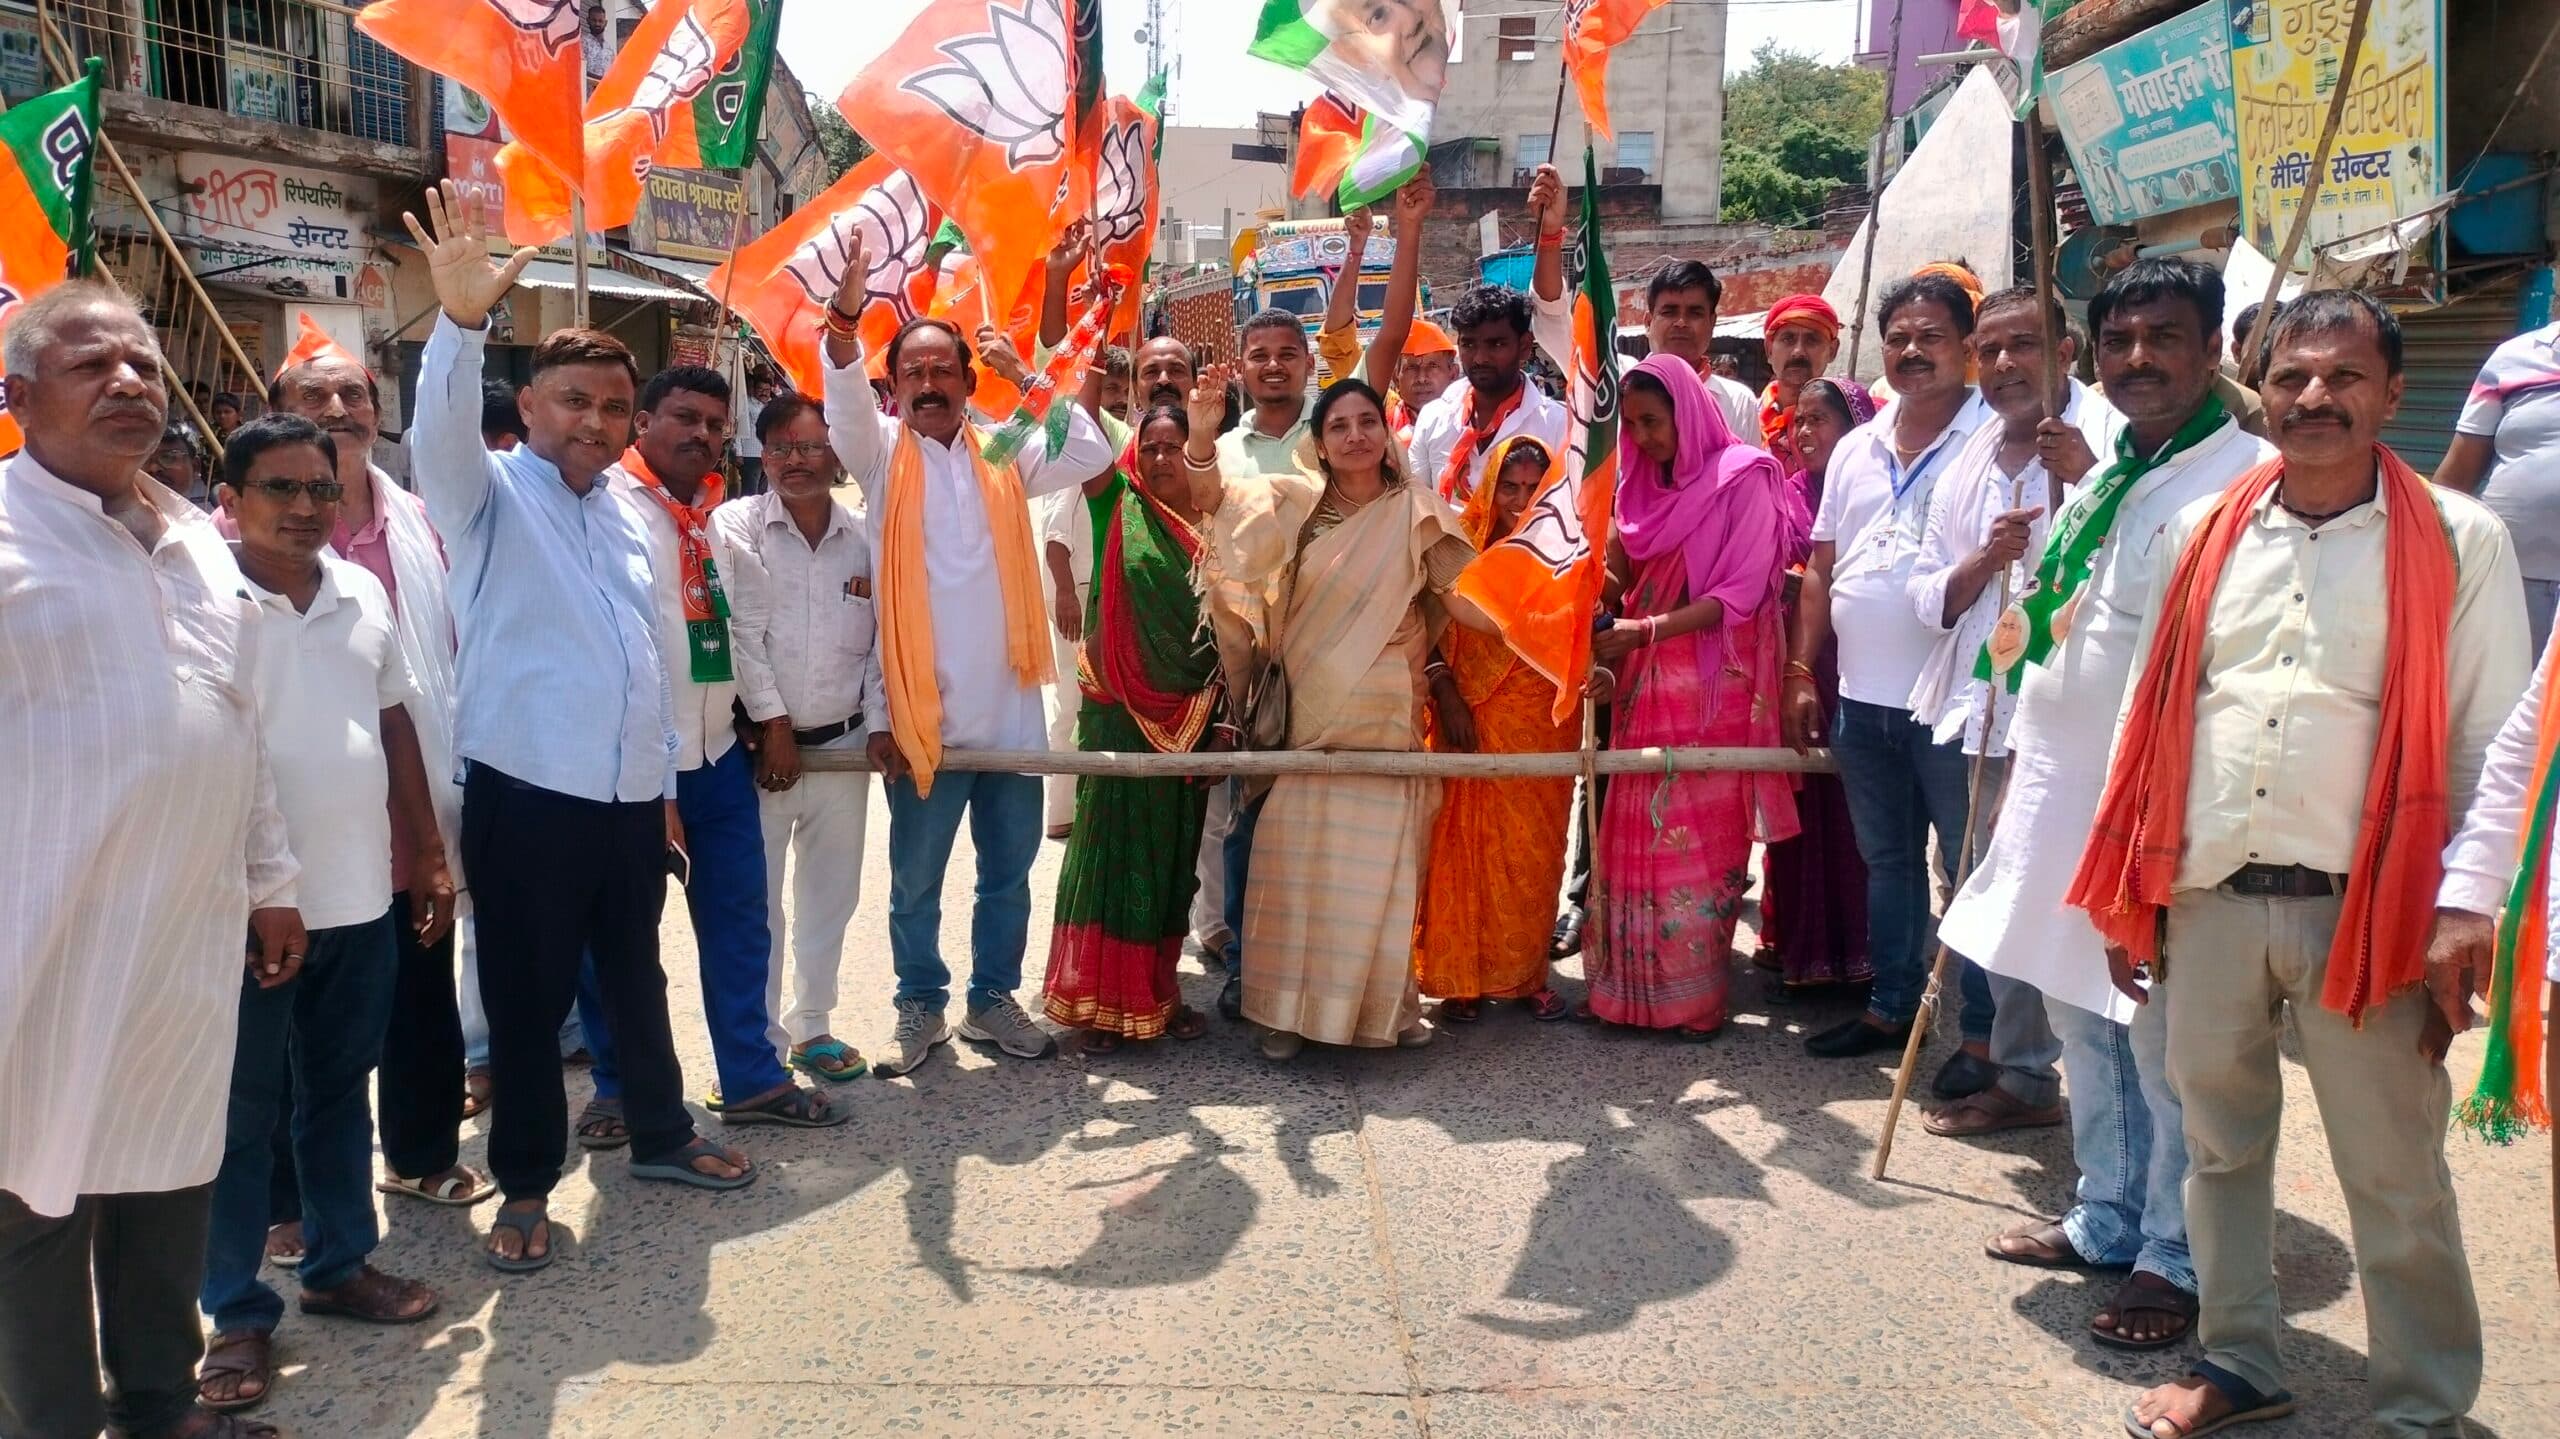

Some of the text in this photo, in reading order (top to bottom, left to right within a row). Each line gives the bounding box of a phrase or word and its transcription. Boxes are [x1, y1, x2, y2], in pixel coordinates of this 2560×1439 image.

[2330, 146, 2392, 184] सेन्टर
[192, 169, 278, 235] धीरज
[287, 215, 349, 250] सेन्टर
